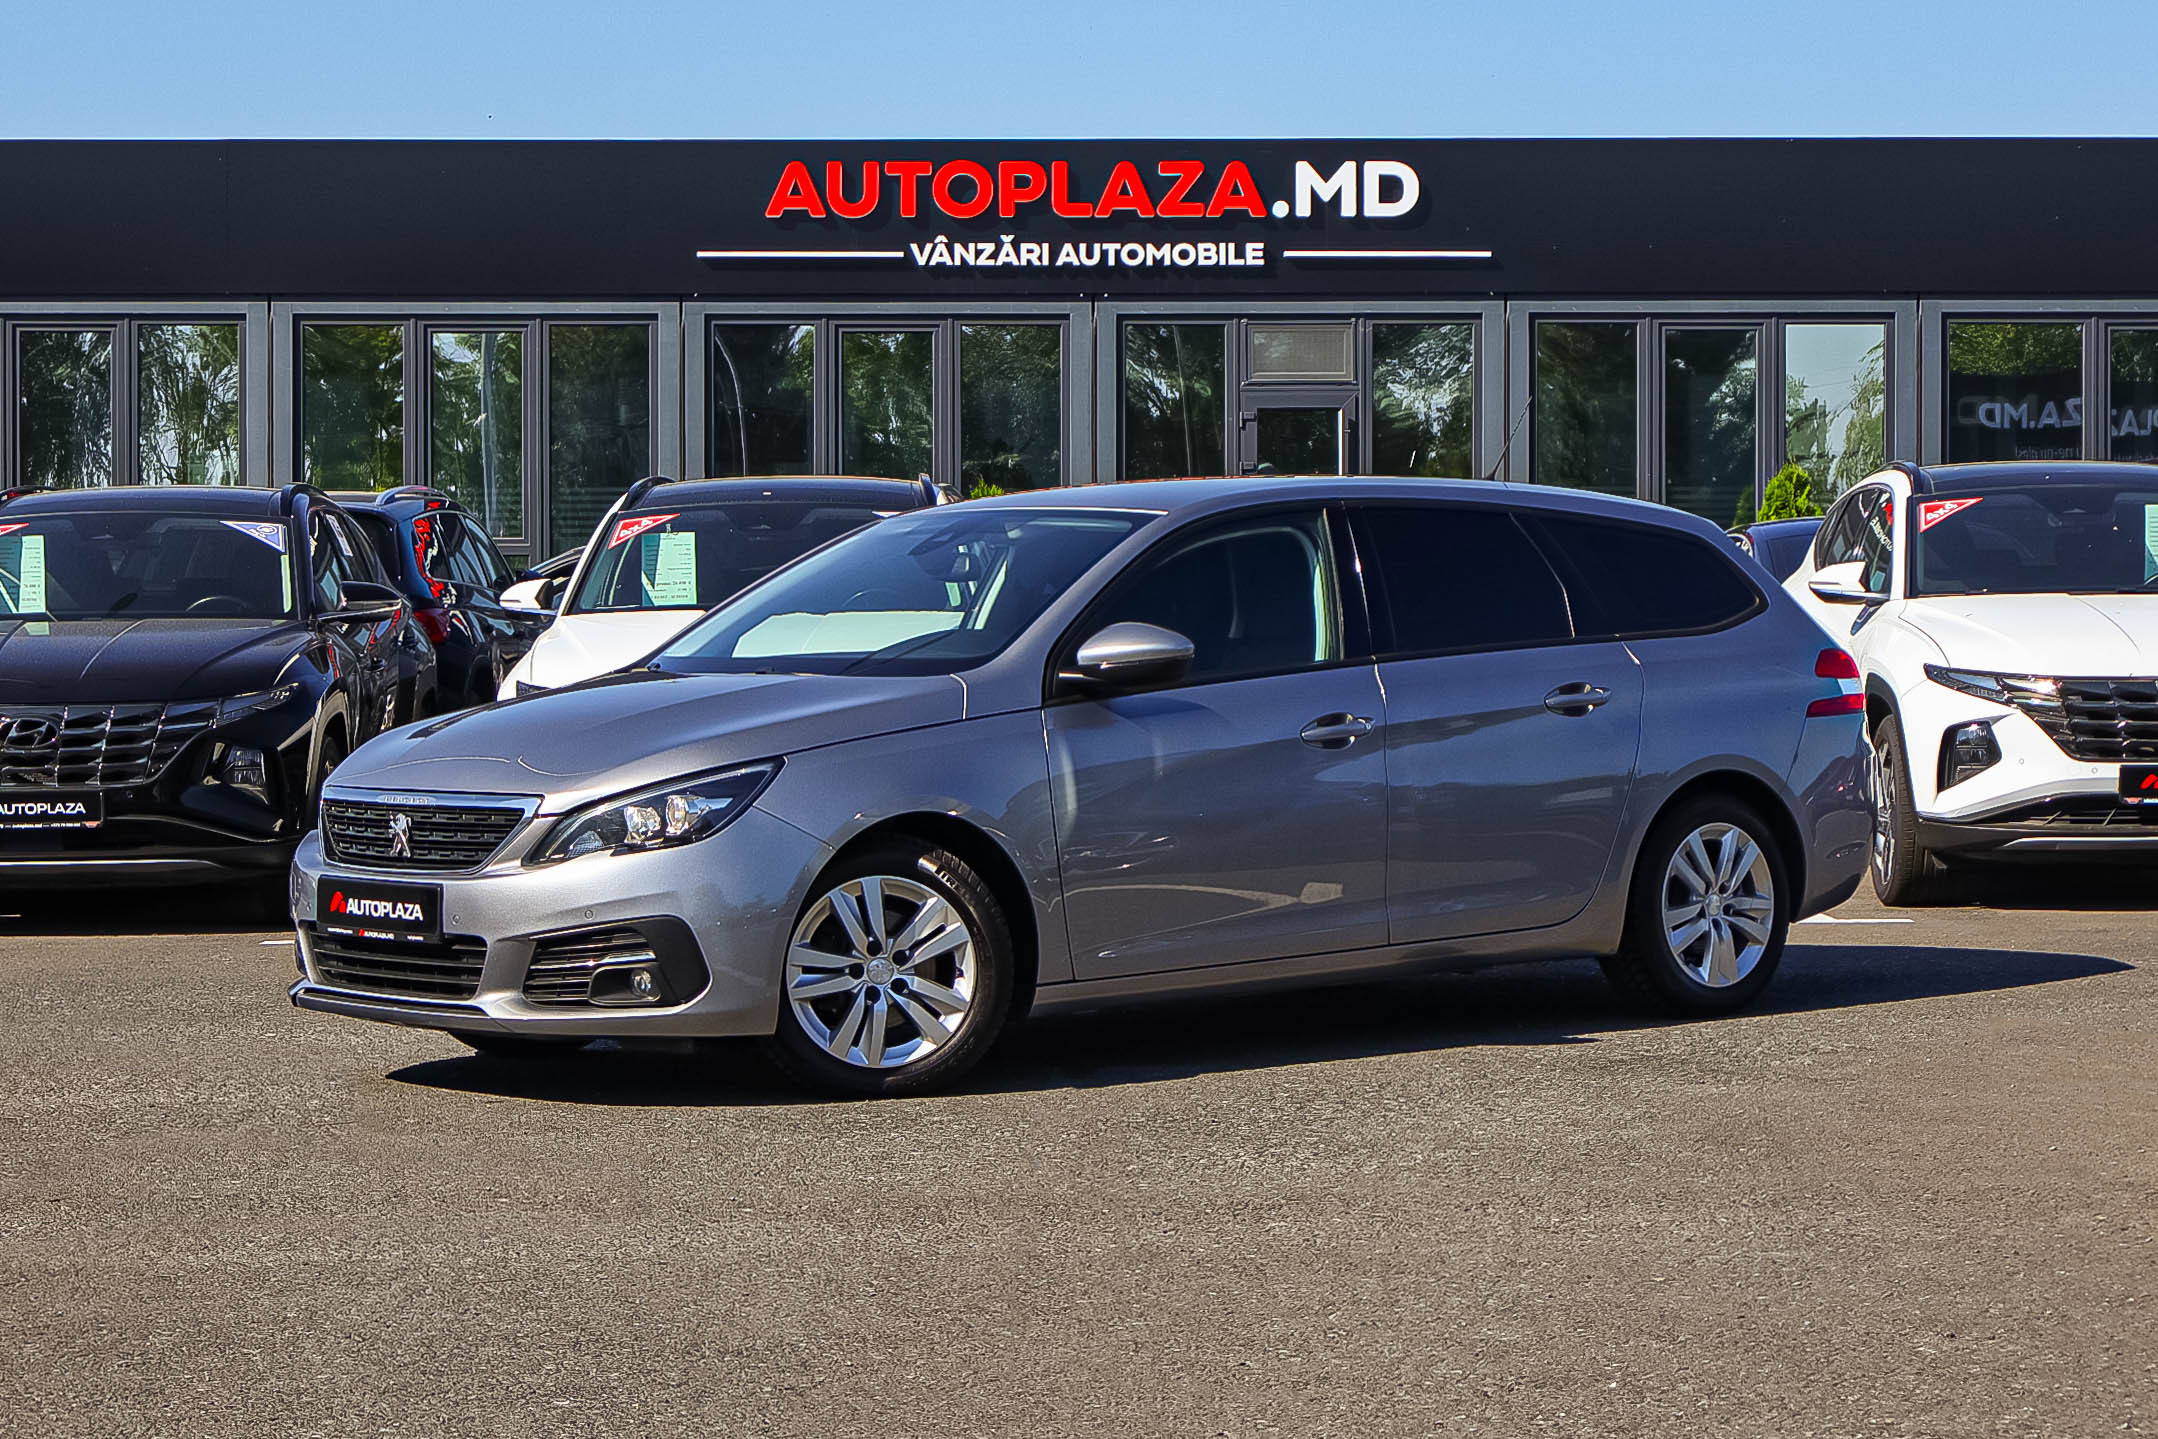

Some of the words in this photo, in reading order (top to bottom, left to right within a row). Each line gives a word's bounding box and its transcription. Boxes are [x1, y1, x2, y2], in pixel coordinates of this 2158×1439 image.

[765, 159, 1420, 218] AUTOPLAZA.MD
[910, 234, 1049, 266] VÂNZĂRI
[1055, 242, 1265, 266] AUTOMOBILE
[346, 898, 423, 920] AUTOPLAZA
